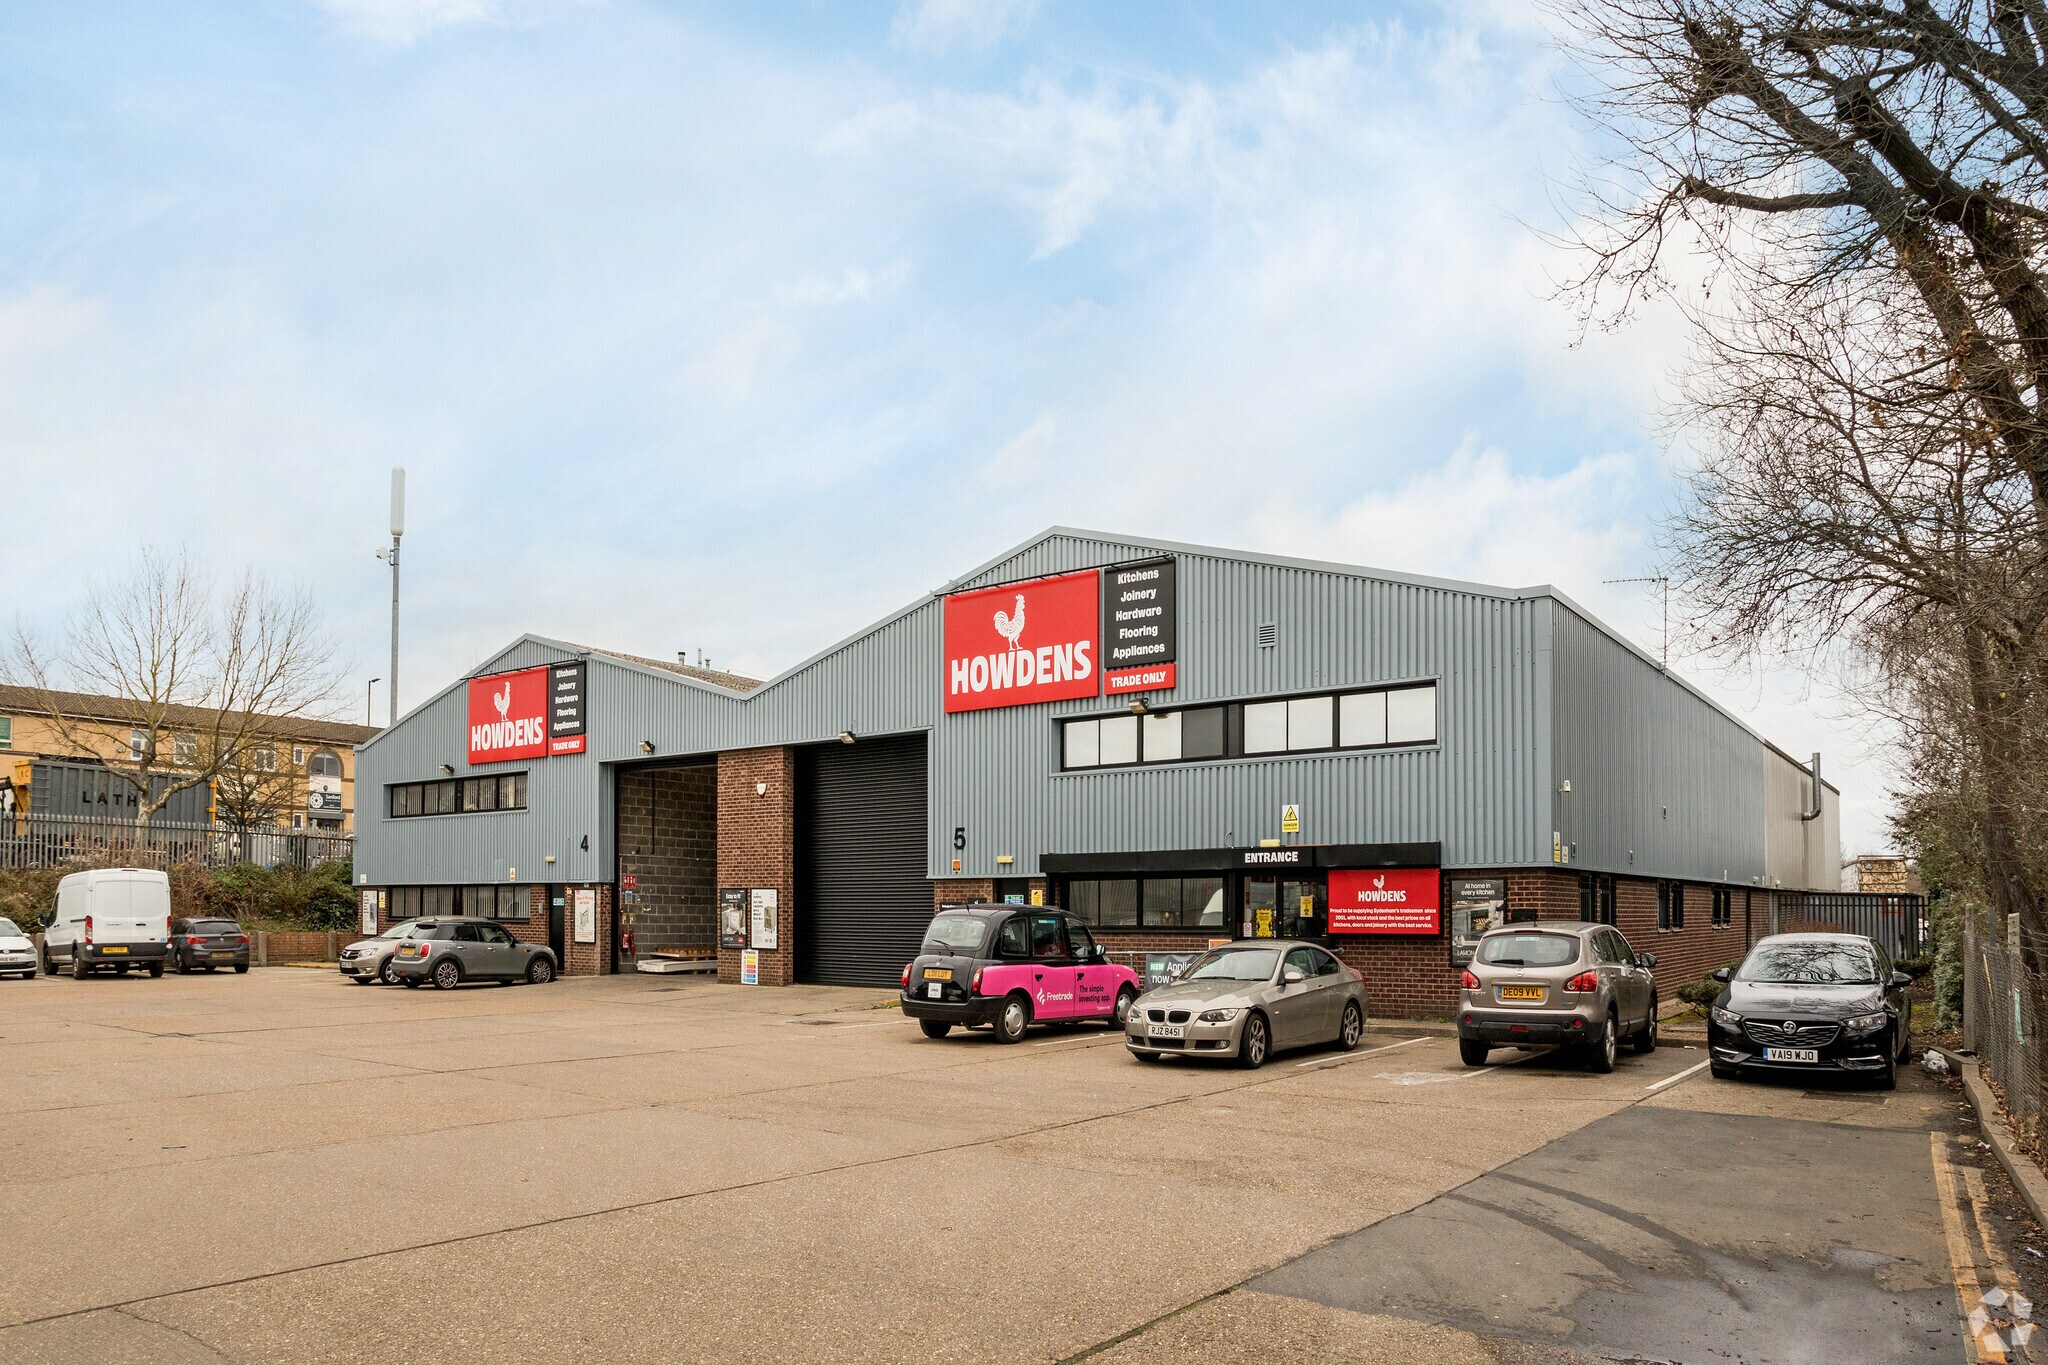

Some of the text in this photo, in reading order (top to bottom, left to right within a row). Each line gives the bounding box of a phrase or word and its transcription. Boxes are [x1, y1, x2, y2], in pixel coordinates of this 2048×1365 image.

[1117, 568, 1159, 585] Kitchens
[1120, 587, 1157, 603] Joinery
[1115, 605, 1162, 622] Hardware
[1119, 625, 1158, 640] Flooring
[1112, 642, 1165, 660] Appliances
[556, 668, 577, 678] Kitchens
[951, 640, 1092, 695] HOWDENS
[1111, 671, 1167, 688] TRADE ONLY
[557, 681, 576, 691] Joinery
[555, 694, 578, 704] Hardware
[557, 707, 576, 717] Flooring
[554, 720, 580, 731] Appliances
[471, 716, 544, 752] HOWDENS
[553, 740, 580, 751] TRADE ONLY
[581, 835, 589, 852] 4
[953, 827, 966, 850] 5
[1245, 851, 1298, 863] ENTRANCE
[1358, 890, 1406, 902] HOWDENS
[1150, 963, 1164, 971] NEW
[1152, 975, 1169, 984] now
[1079, 985, 1104, 993] The simple
[1503, 986, 1541, 997] DE09 VVL
[1047, 992, 1073, 1001] Freetrade
[1079, 995, 1100, 1003] investing
[1151, 1027, 1180, 1036] RJZ 8451
[1771, 1050, 1814, 1061] VA19 WJO
